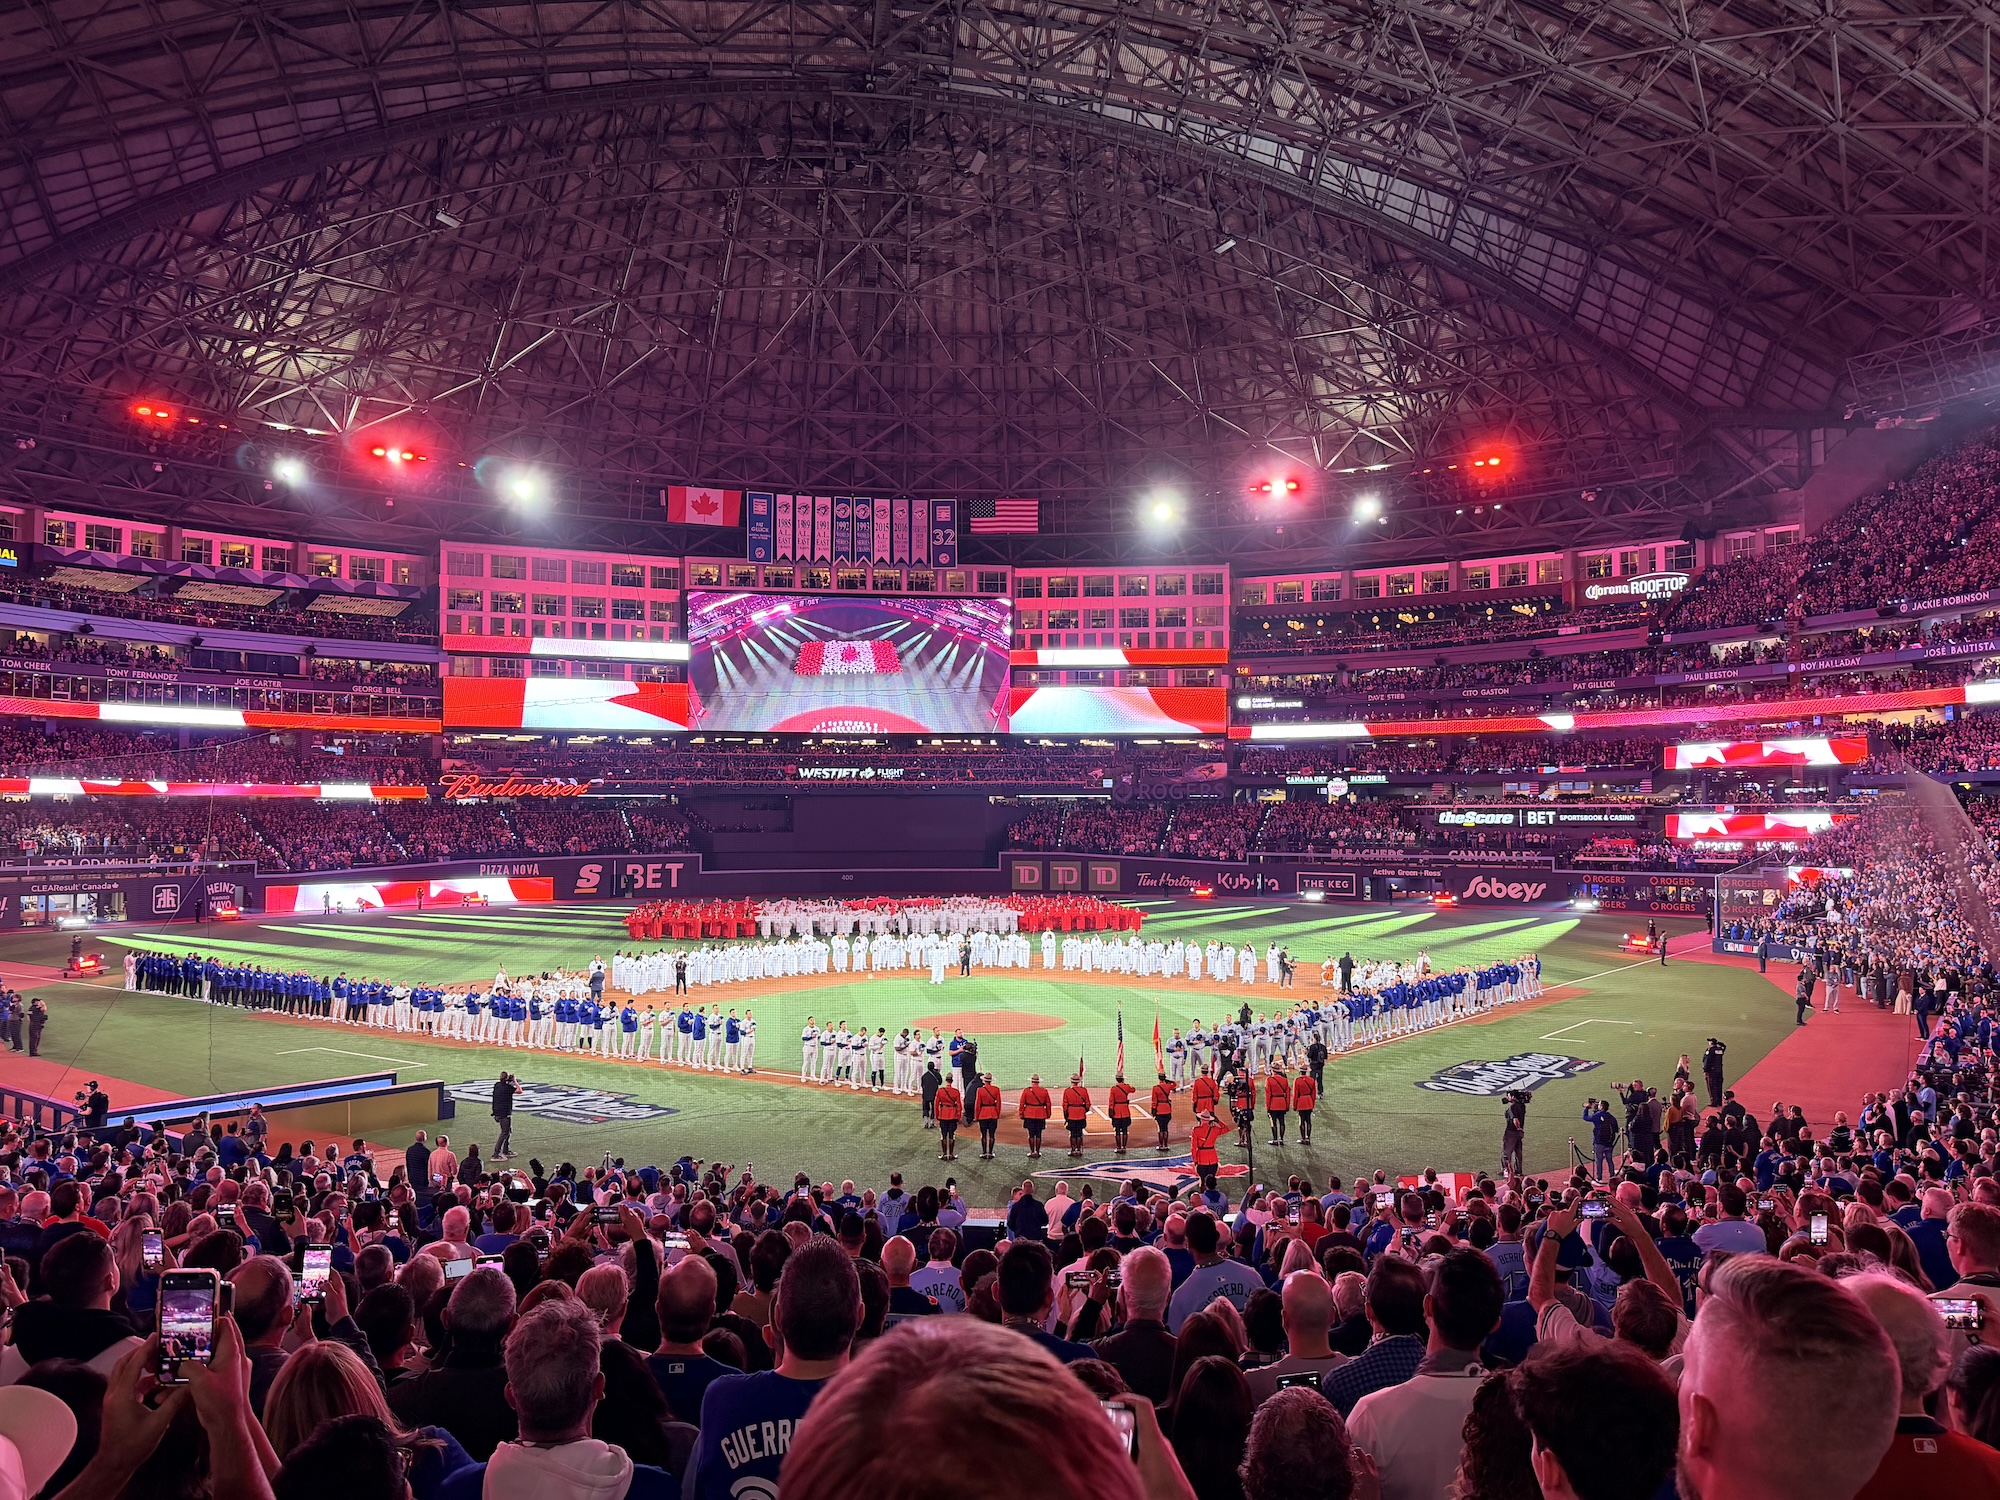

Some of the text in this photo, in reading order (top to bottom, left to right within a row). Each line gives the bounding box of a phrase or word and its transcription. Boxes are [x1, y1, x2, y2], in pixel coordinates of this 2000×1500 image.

[817, 521, 829, 530] 1991
[836, 521, 850, 531] 1992
[857, 521, 870, 532] 1993
[876, 522, 889, 532] 2015
[933, 528, 956, 546] 32
[1585, 576, 1688, 600] Corona ROOFTOP
[1646, 590, 1672, 600] PATIO
[1912, 598, 1941, 611] JACKIE
[1943, 591, 1990, 606] ROBINSON
[1924, 641, 1996, 658] JOSÉ BAUTISTA
[0, 658, 52, 671] TOM CHEEK
[1801, 657, 1861, 671] ROY HALLADAY
[105, 668, 179, 682] TONY FERNANDEZ
[1685, 670, 1739, 682] PAUL BEESTON
[234, 678, 282, 688] JOE CARTER
[1572, 680, 1616, 691] PAT GILLICK
[352, 684, 402, 695] GEORGE BELL
[1462, 687, 1510, 697] CITO GASTON
[877, 768, 905, 776] FLIGHT
[439, 774, 593, 799] Budweiser
[1140, 783, 1225, 800] ROGERS
[1438, 811, 1515, 825] theScore
[1527, 811, 1557, 825] BET
[1559, 814, 1603, 822] SPORTSBOOK
[1609, 814, 1636, 822] CASINO
[1448, 850, 1506, 862] CANADA
[480, 864, 510, 876] PIZZA
[621, 863, 685, 889] BET
[1015, 866, 1040, 884] TD
[1053, 866, 1079, 885] TD
[1091, 866, 1117, 885] TD
[1373, 868, 1396, 876] Active
[1137, 872, 1201, 888] Tim Hortons
[1303, 879, 1350, 889] THE KEG
[1592, 875, 1626, 884] ROGERS
[1660, 877, 1695, 886] ROGERS
[1731, 879, 1769, 888] ROGERS
[82, 882, 112, 891] Canada
[206, 881, 236, 896] HEINZ
[1463, 876, 1547, 903] Sobeys
[209, 900, 232, 911] MAYO
[1599, 901, 1627, 909] OGERS
[1661, 903, 1696, 912] ROGERS
[1732, 905, 1770, 915] ROGERS
[885, 1204, 902, 1218] 27
